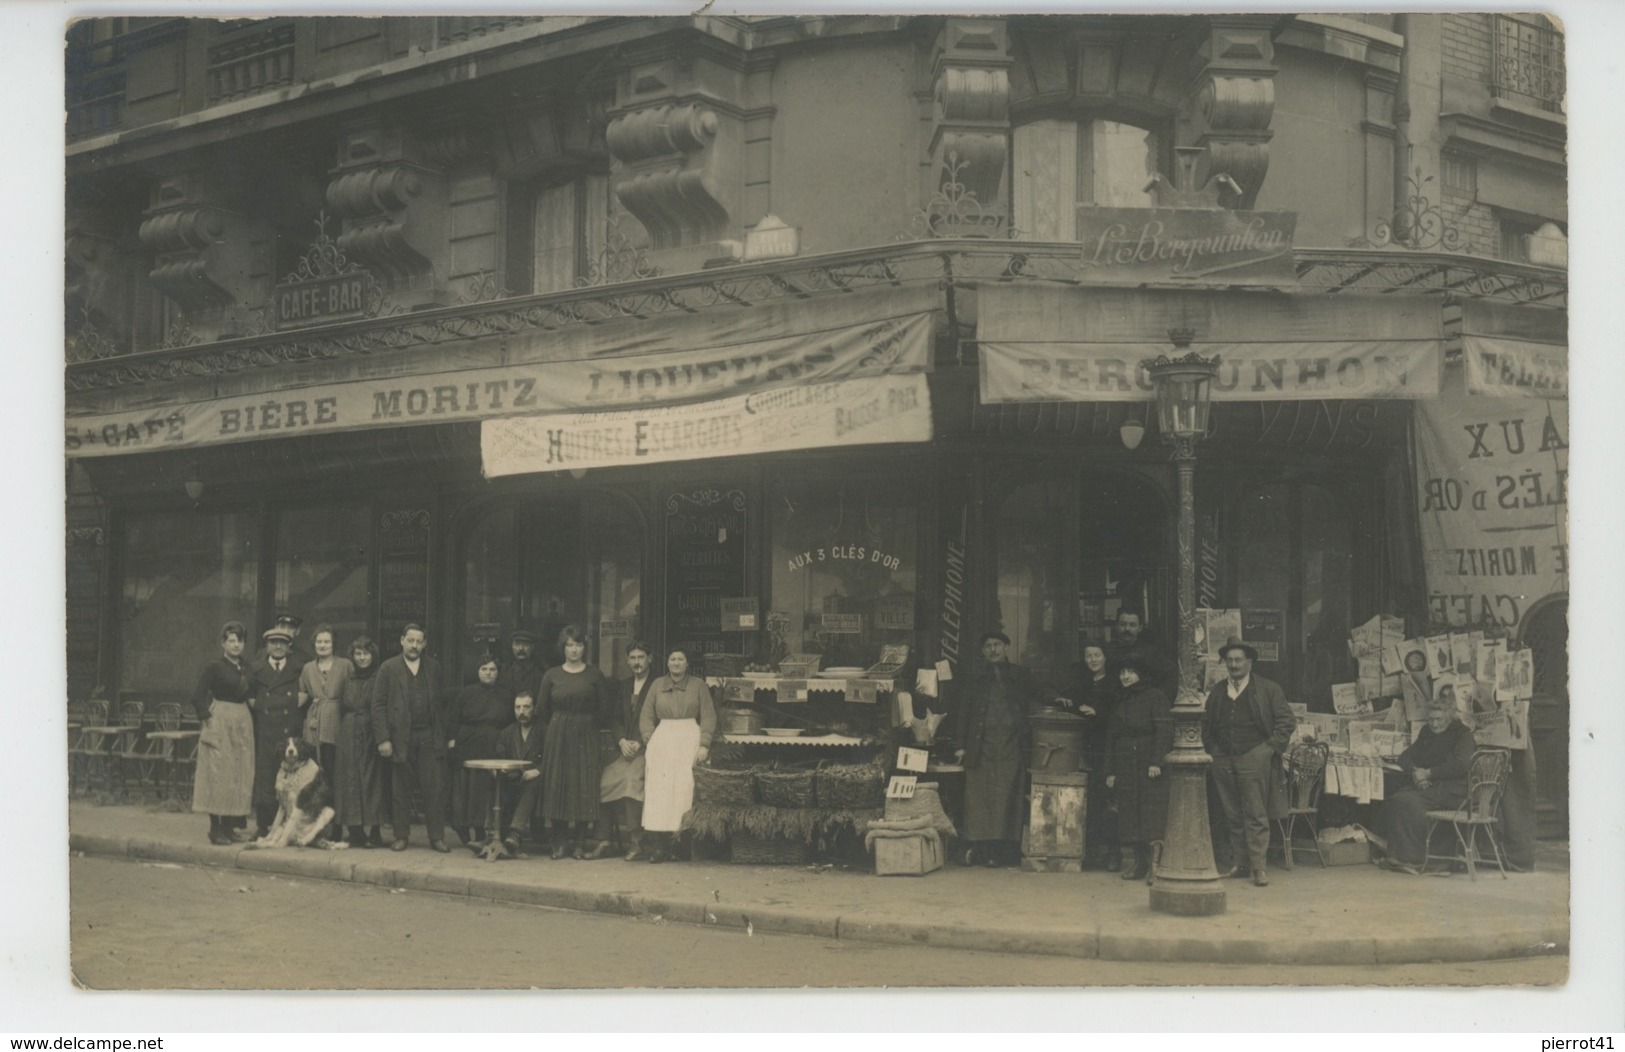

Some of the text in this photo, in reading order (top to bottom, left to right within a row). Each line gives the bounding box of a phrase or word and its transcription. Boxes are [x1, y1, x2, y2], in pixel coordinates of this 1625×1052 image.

[280, 281, 362, 320] CAFÉ-BAR
[1018, 357, 1410, 392] BERGUNHON
[219, 397, 337, 436] BIÈRE
[372, 377, 537, 420] MORITZ
[787, 543, 901, 573] AUX 3 CLÉS D'OR
[1199, 536, 1218, 609] PHONE
